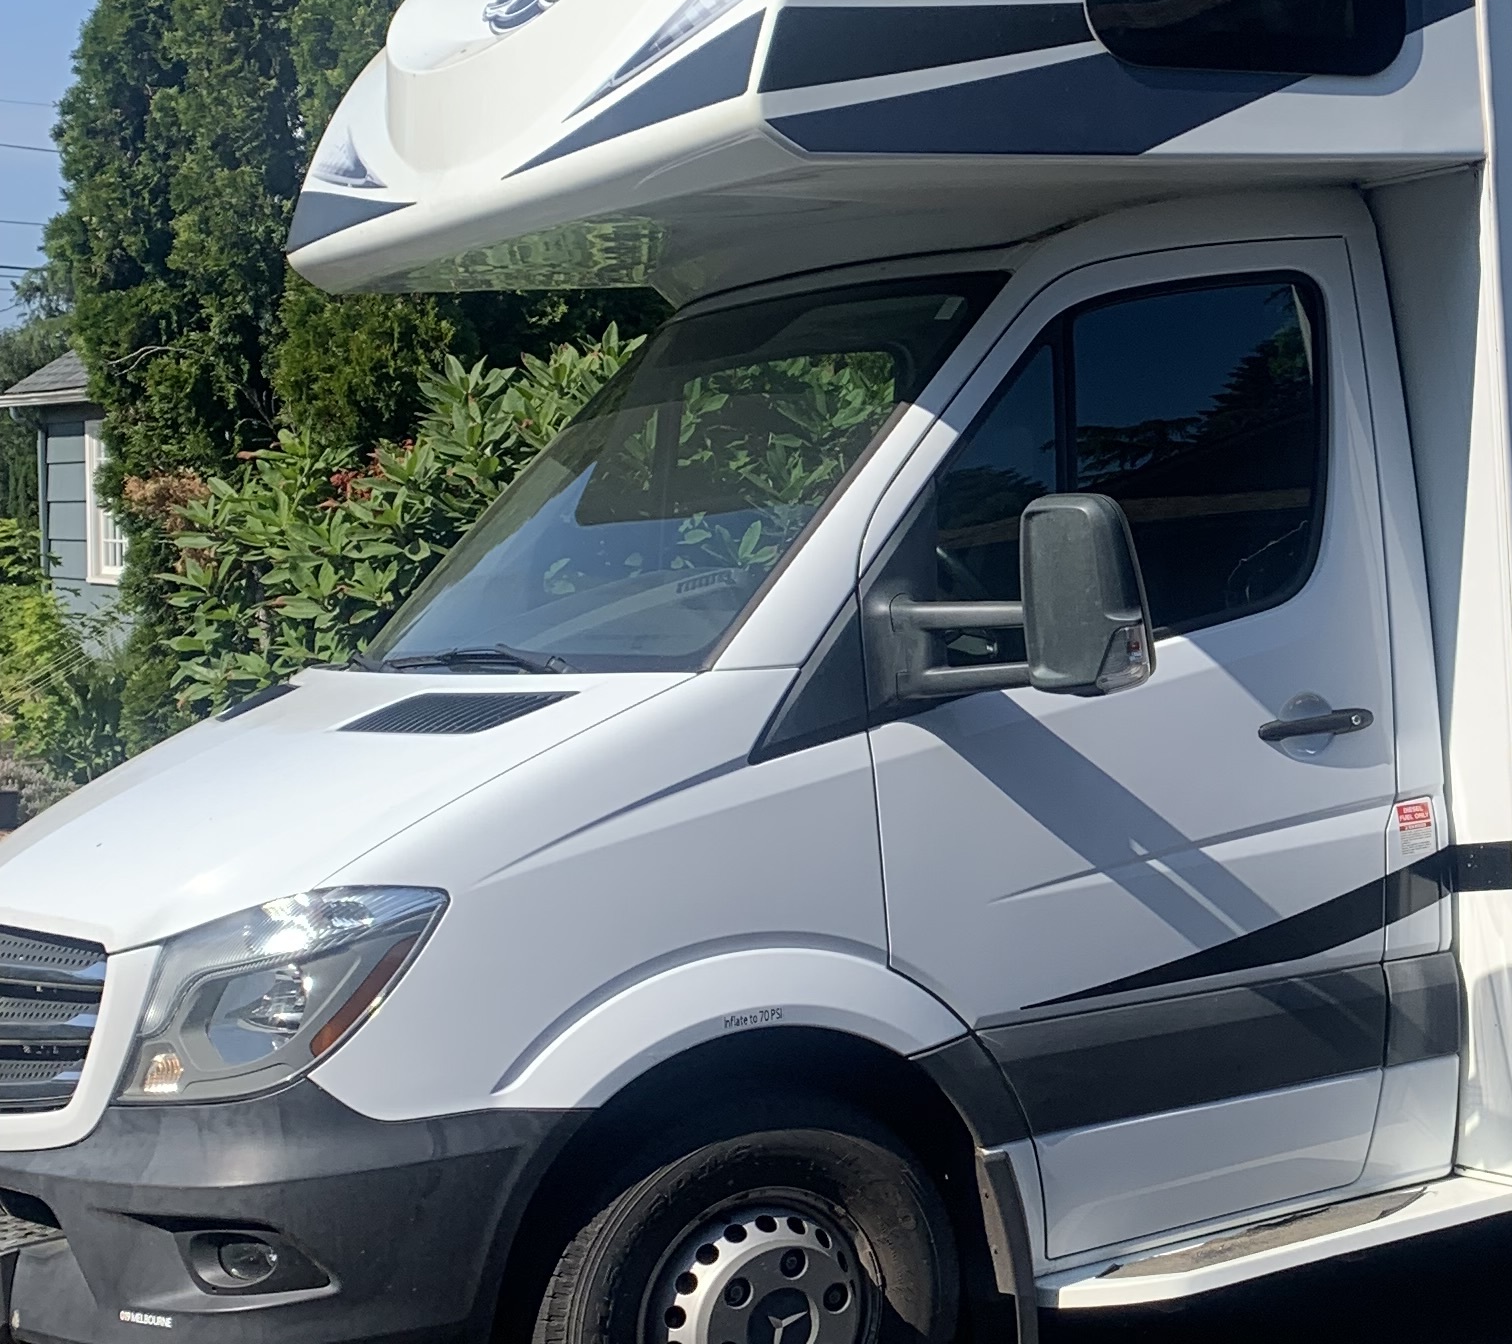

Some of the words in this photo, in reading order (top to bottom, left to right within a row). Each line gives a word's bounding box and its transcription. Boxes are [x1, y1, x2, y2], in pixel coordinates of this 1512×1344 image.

[749, 1014, 758, 1024] to
[759, 1010, 769, 1023] 70
[770, 1007, 783, 1020] PSI
[131, 1312, 173, 1328] MELBOURNE
